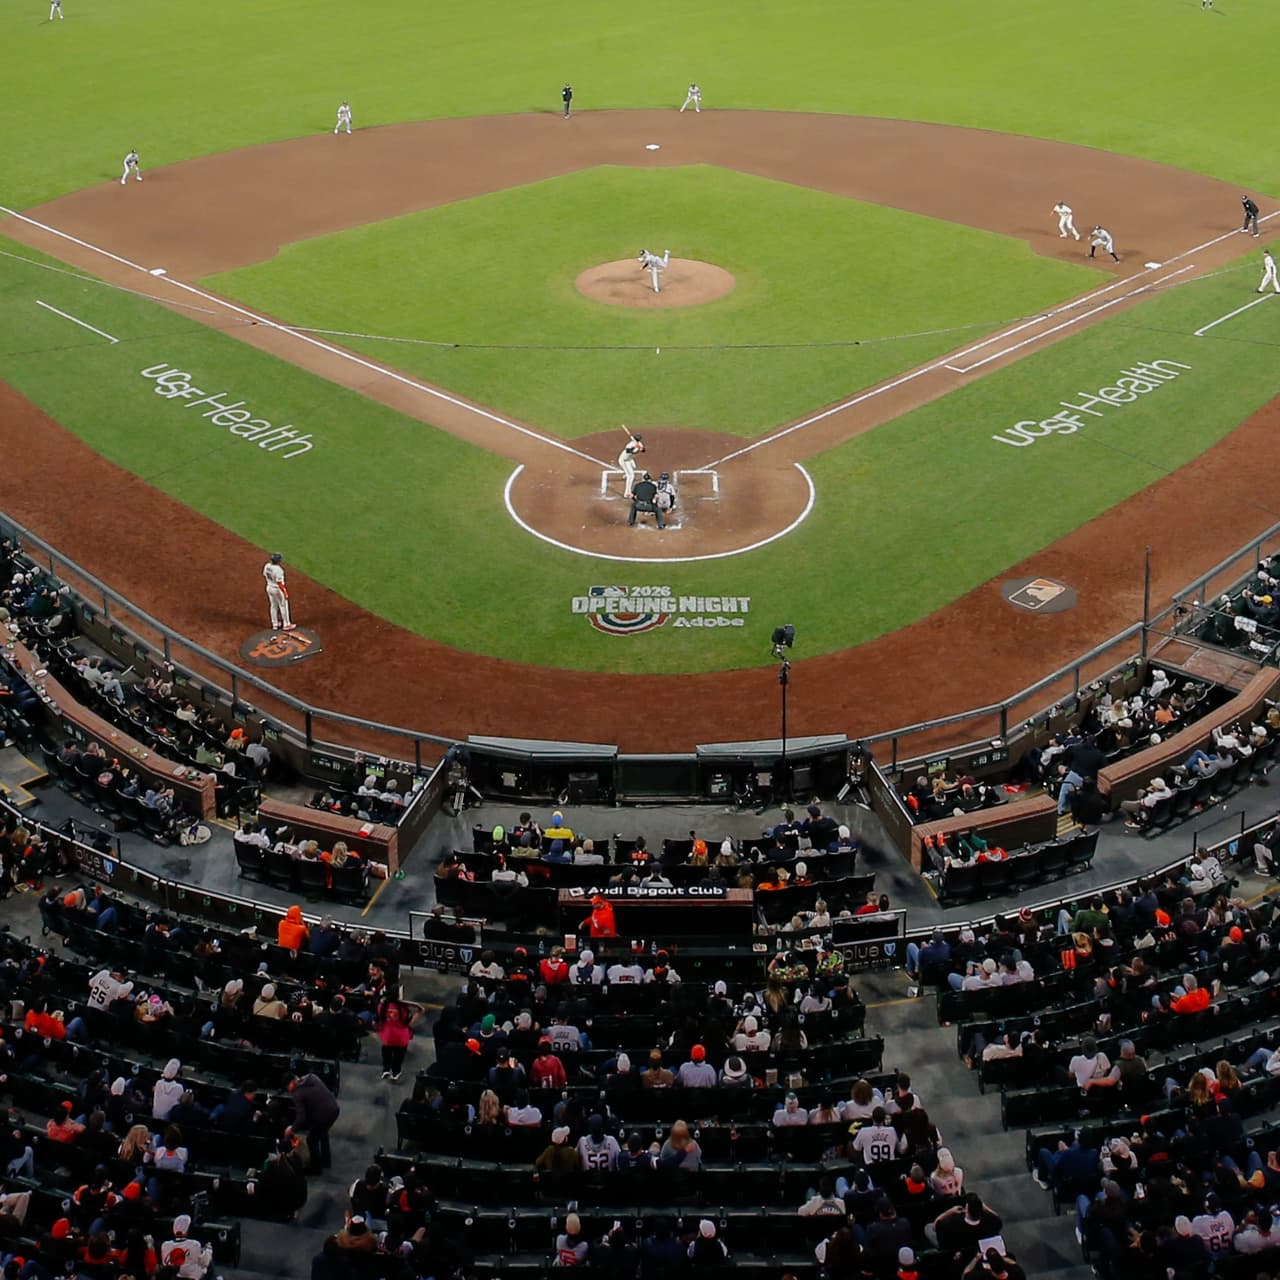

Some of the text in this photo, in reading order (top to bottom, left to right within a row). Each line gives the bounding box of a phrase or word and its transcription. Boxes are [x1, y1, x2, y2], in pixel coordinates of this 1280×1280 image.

[140, 363, 313, 459] UCSF Health
[991, 359, 1193, 447] UCSF Health
[631, 586, 671, 597] 2026
[572, 596, 751, 614] OPENING NIGHT
[671, 616, 745, 628] Adobe
[587, 885, 725, 898] Audi Dugout Club
[418, 942, 456, 960] blue
[844, 945, 880, 961] blue
[91, 986, 108, 1005] 25
[587, 1153, 609, 1170] 52
[870, 1144, 892, 1162] 99
